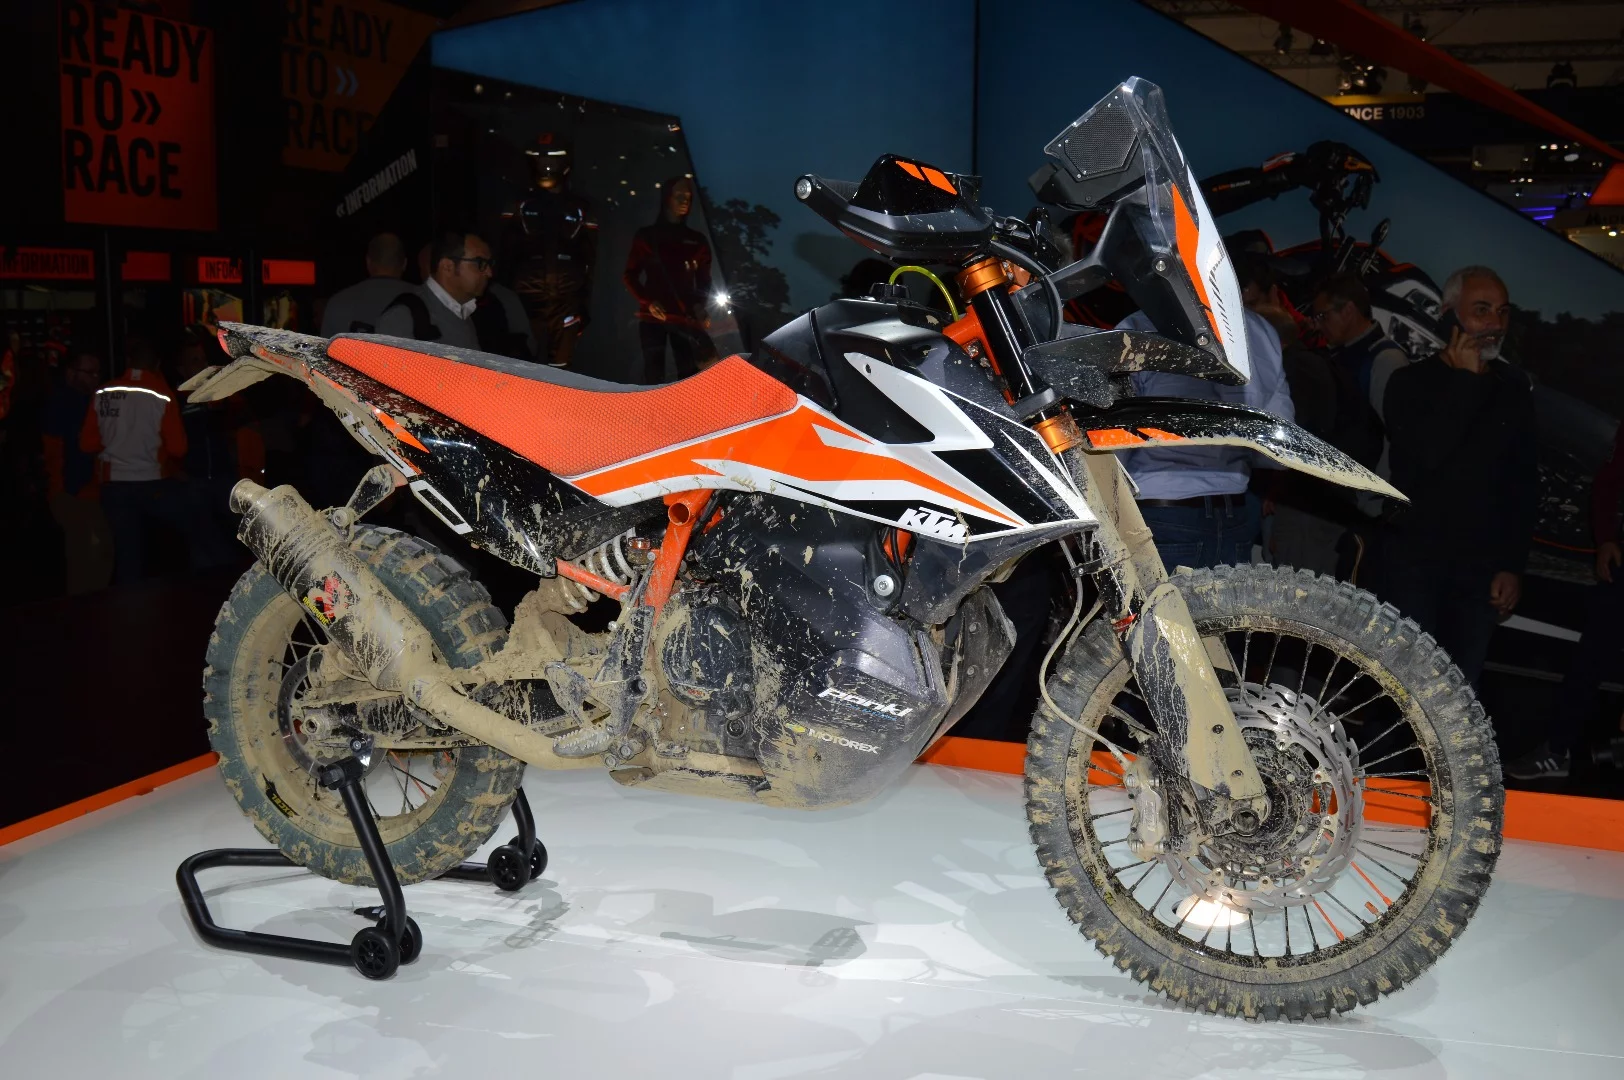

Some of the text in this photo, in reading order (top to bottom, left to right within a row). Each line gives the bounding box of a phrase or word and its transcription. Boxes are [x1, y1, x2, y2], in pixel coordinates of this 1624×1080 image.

[62, 2, 206, 83] READY
[283, 0, 393, 64] READY
[63, 64, 122, 131] TO
[283, 40, 329, 101] TO
[1389, 105, 1426, 120] 1903
[65, 129, 182, 199] RACE
[343, 148, 418, 216] INFORMATION
[897, 506, 968, 538] KTM
[807, 727, 880, 755] MOTOREX
